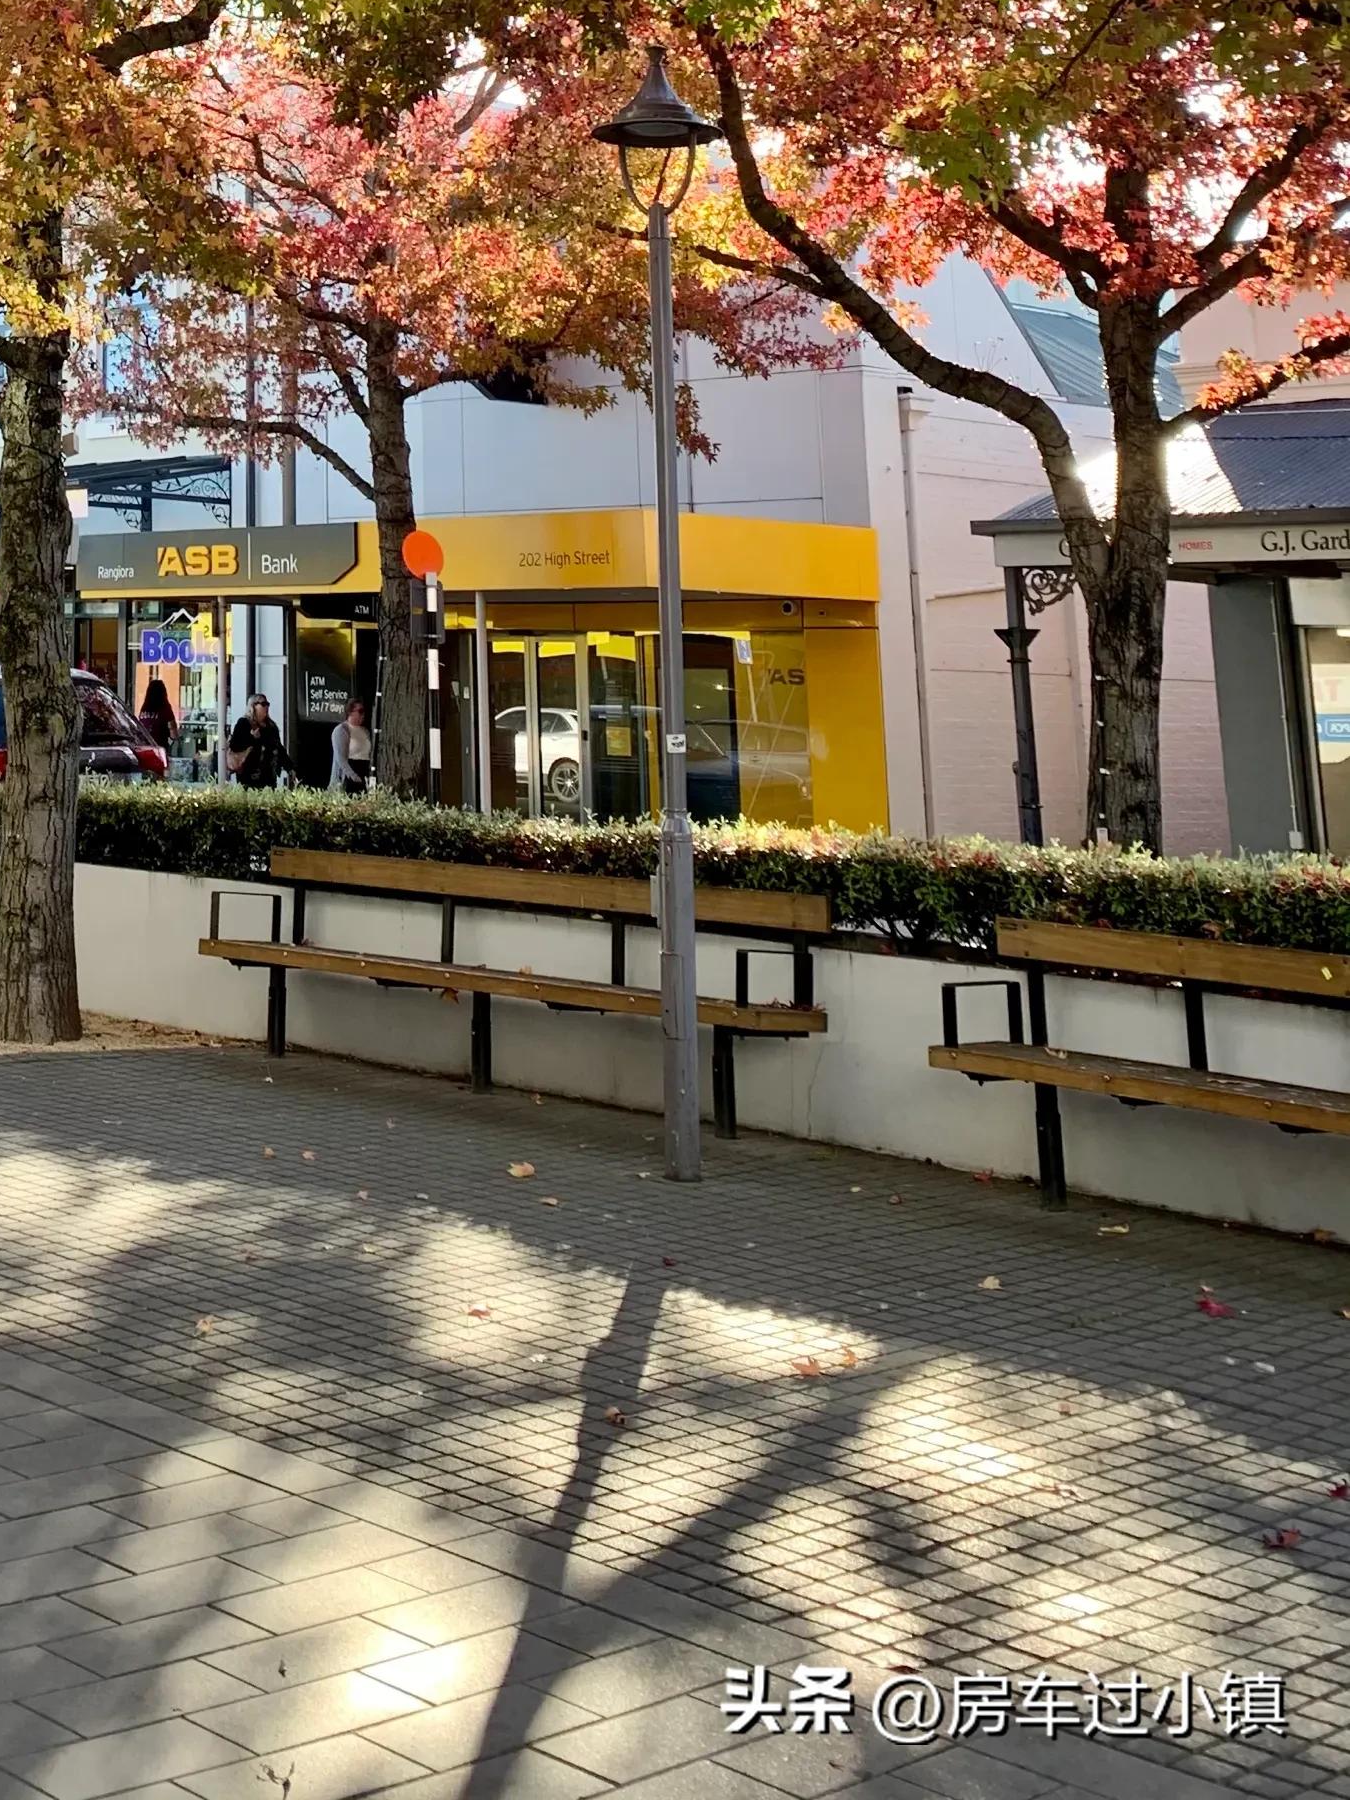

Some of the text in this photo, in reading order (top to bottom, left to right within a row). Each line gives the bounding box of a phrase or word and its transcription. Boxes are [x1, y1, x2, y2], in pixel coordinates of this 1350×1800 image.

[97, 544, 299, 581] Rangiora ASB Bank
[519, 550, 610, 569] 202 High Street
[354, 605, 370, 615] ATM
[310, 676, 326, 686] ATM
[310, 689, 348, 700] Self Service
